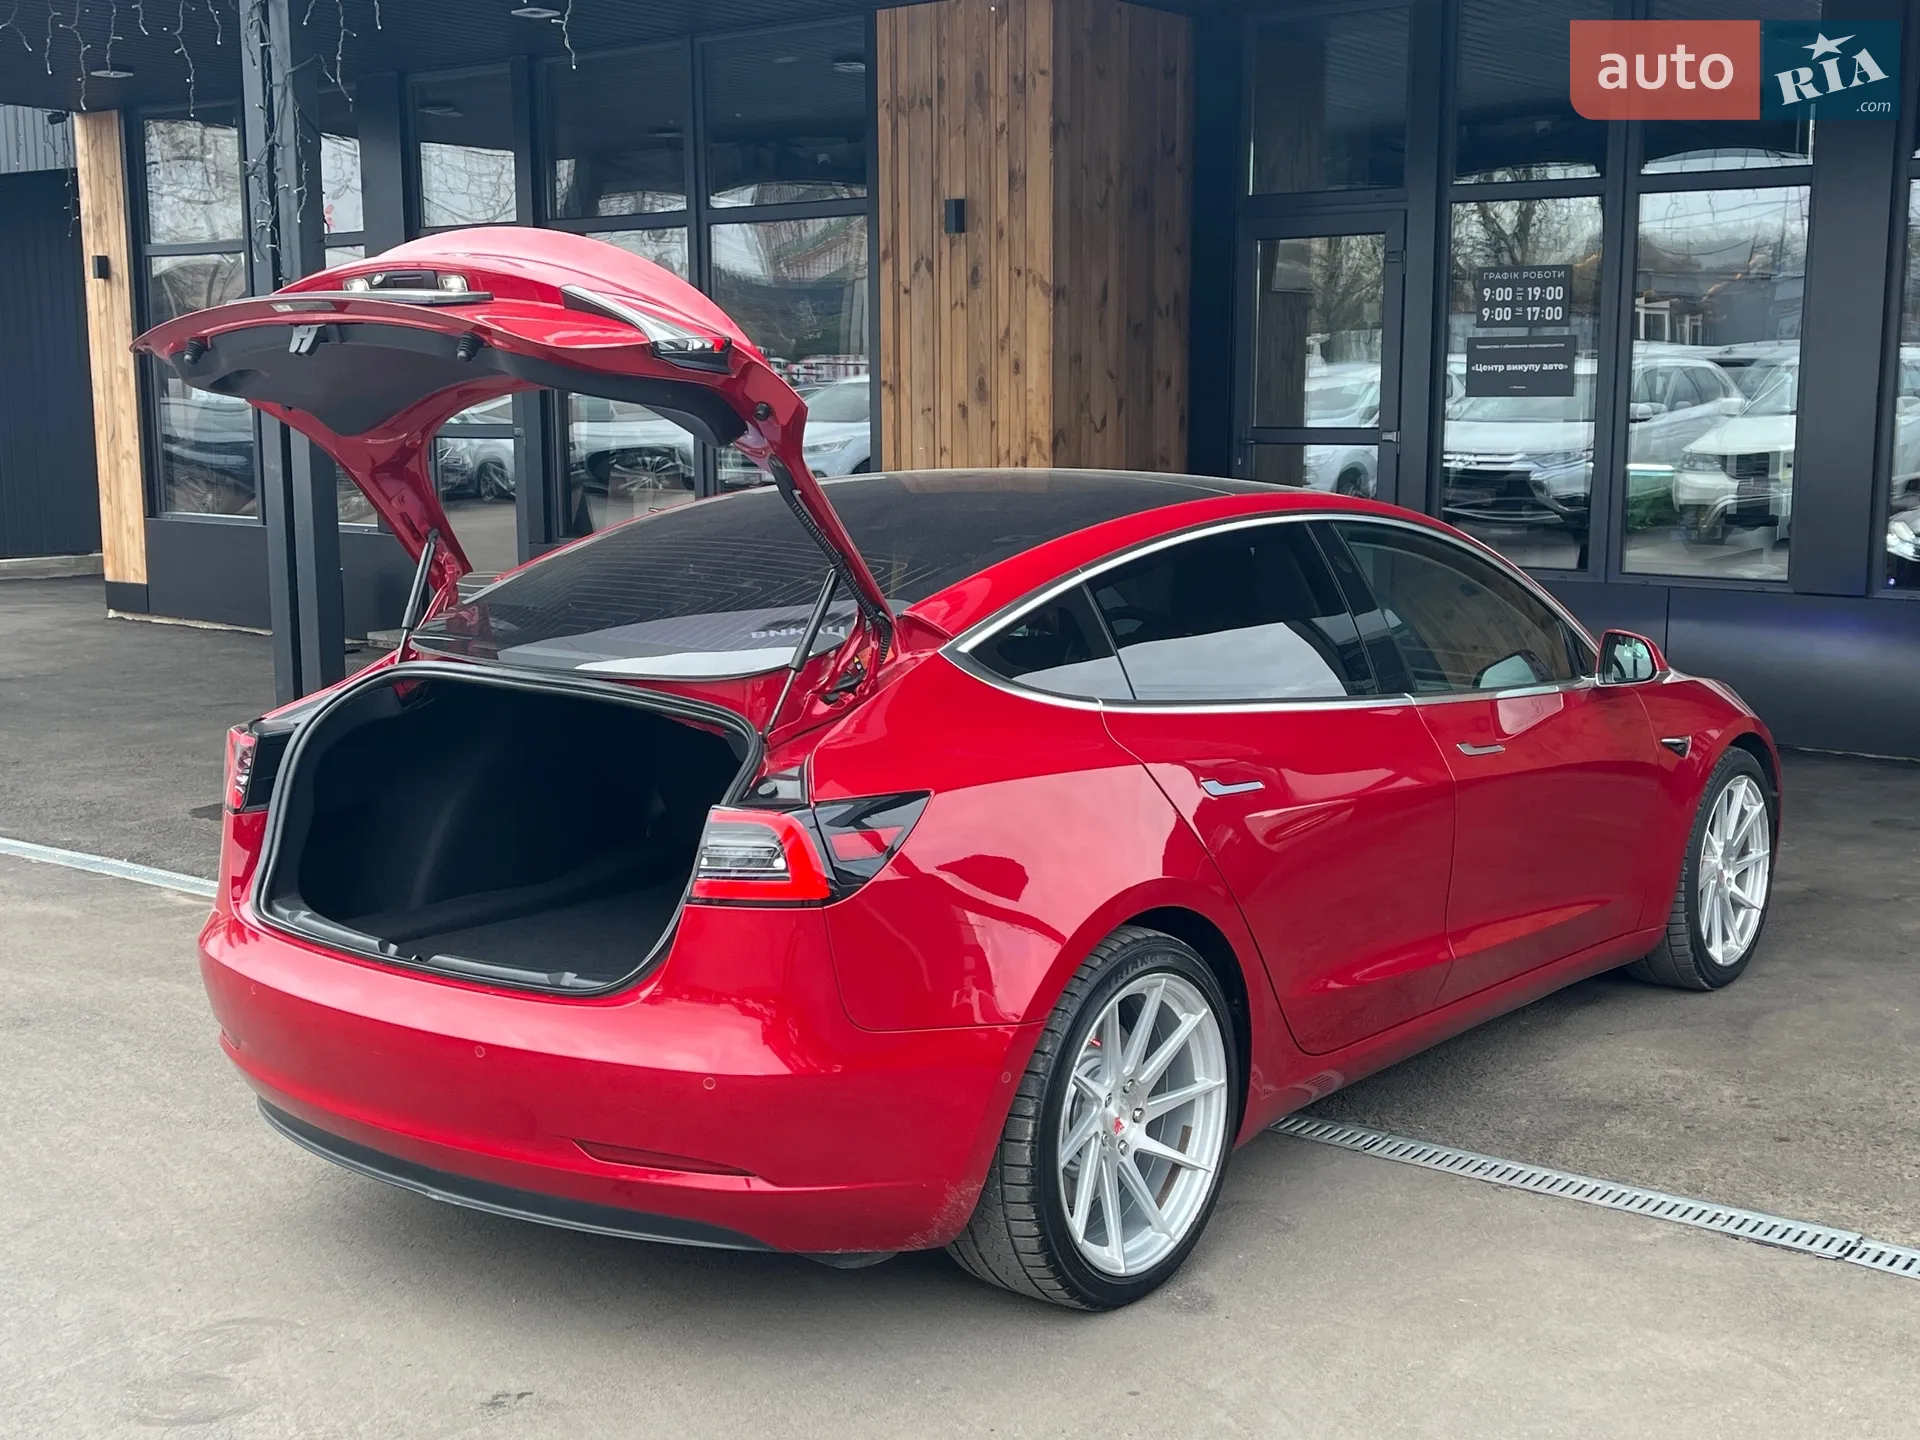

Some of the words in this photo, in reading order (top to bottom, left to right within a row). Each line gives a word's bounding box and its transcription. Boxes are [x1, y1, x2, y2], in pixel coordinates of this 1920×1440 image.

[1483, 272, 1520, 280] ГРАФІК
[1522, 270, 1565, 279] РОБОТИ
[1483, 287, 1513, 301] 9:00
[1527, 285, 1564, 301] 19:00
[1482, 307, 1512, 321] 9:00
[1526, 306, 1563, 321] 17:00
[1471, 363, 1505, 373] «Центр
[1506, 363, 1541, 373] викупу
